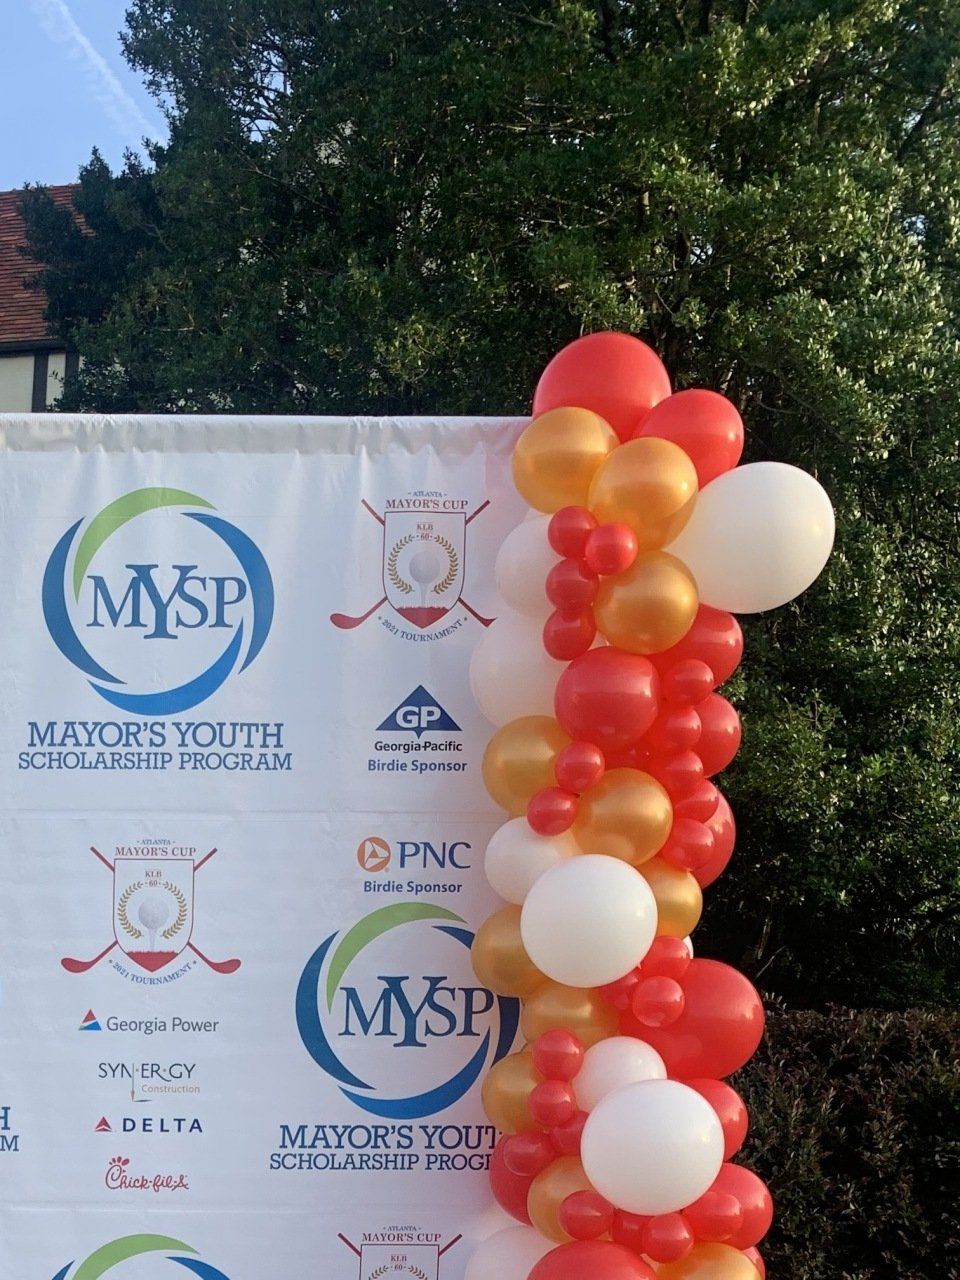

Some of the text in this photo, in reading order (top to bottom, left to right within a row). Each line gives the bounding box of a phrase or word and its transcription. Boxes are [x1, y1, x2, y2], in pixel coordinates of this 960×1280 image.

[385, 499, 469, 510] MAYOR'S CUP
[86, 564, 247, 639] MYSP
[382, 619, 464, 642] 2021 TOURNAMENT
[395, 705, 441, 728] GP
[27, 722, 284, 749] MAYOR'S YOUTH
[18, 752, 293, 772] SCHOLARSHIP PROGRAM
[368, 759, 468, 774] Birdie Sponsor
[114, 847, 197, 857] MAYOR'S CUP
[396, 841, 472, 869] PNC
[363, 881, 463, 895] Birdie Sponsor
[112, 962, 192, 985] 2021 TOURNAMENT
[338, 976, 494, 1048] MYSP
[106, 1016, 219, 1035] Georgia Power
[141, 1085, 201, 1094] Construction
[122, 1118, 203, 1133] DELTA
[279, 1124, 497, 1150] MAYOR'S YOUT
[270, 1153, 490, 1171] SCHOLARSHIP PROG
[362, 1233, 442, 1243] MAYOR'S CUP
